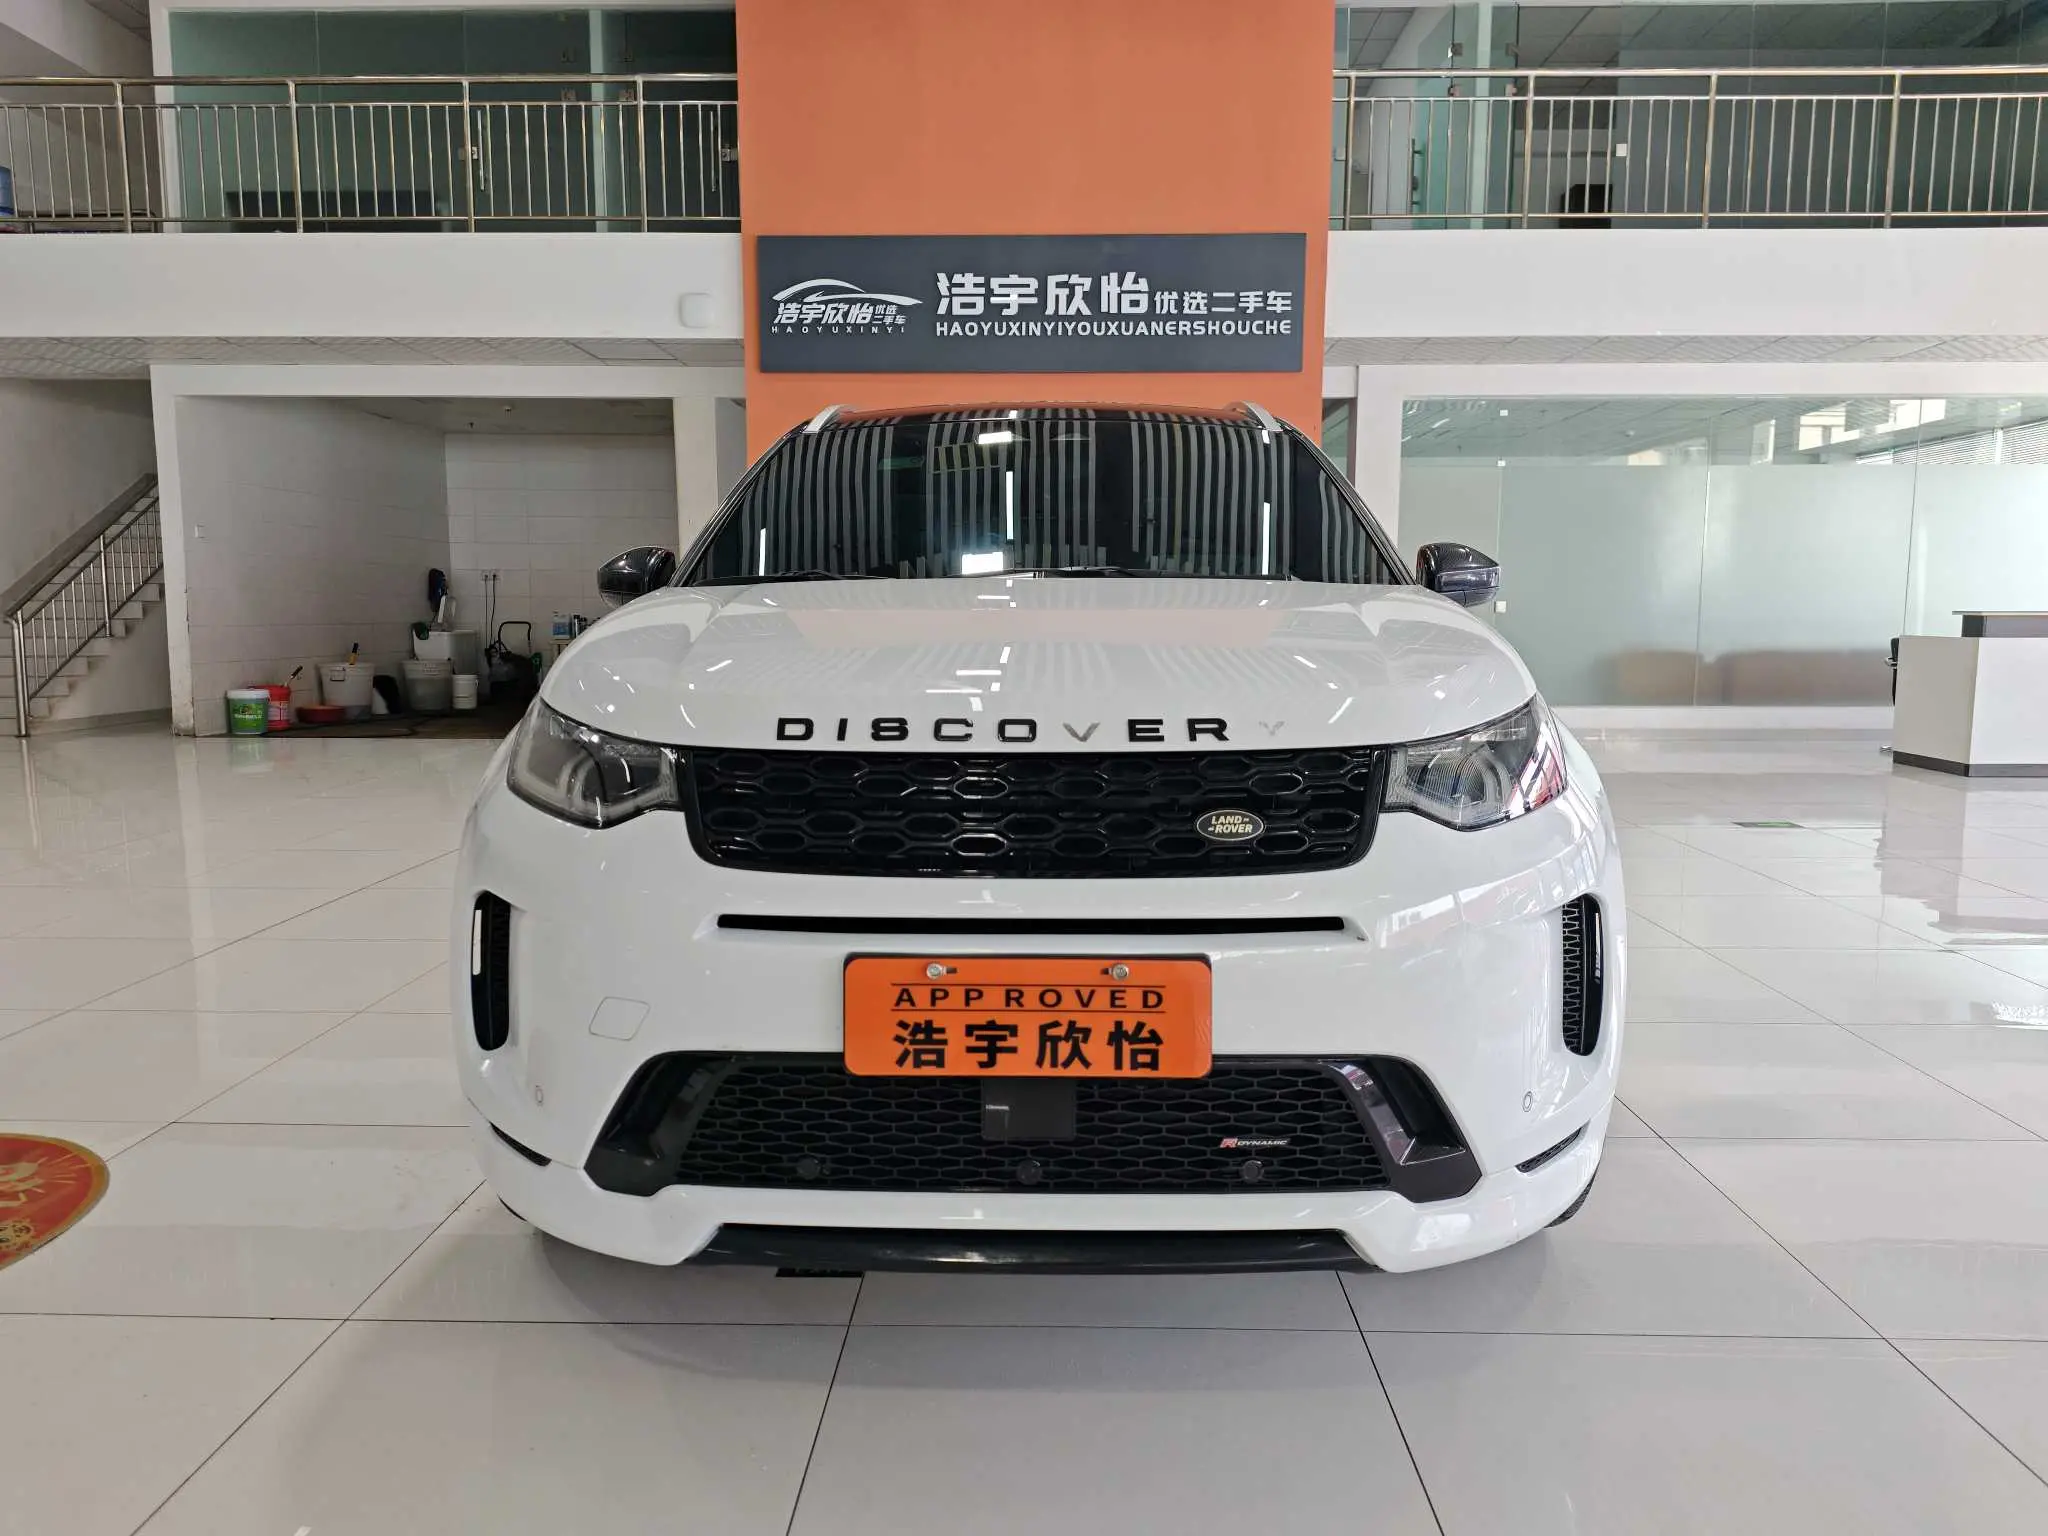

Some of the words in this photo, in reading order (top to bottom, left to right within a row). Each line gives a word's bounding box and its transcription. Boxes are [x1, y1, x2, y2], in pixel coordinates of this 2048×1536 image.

[936, 271, 1149, 316] 浩宇欣怡
[1154, 290, 1293, 315] 优选二手车
[773, 303, 873, 324] 浩宇欣怡
[874, 304, 898, 314] 优选
[872, 315, 906, 325] 二手车
[771, 325, 904, 334] HAOYUXINYI
[936, 319, 1292, 337] HAOYUXINYIYOUXUANERSHOUCHE
[776, 717, 1286, 743] DISCOVERY
[1211, 815, 1242, 825] LAND
[1214, 823, 1253, 834] ROVER
[894, 987, 1164, 1009] APPROVED
[893, 1019, 1164, 1071] 浩宇欣怡
